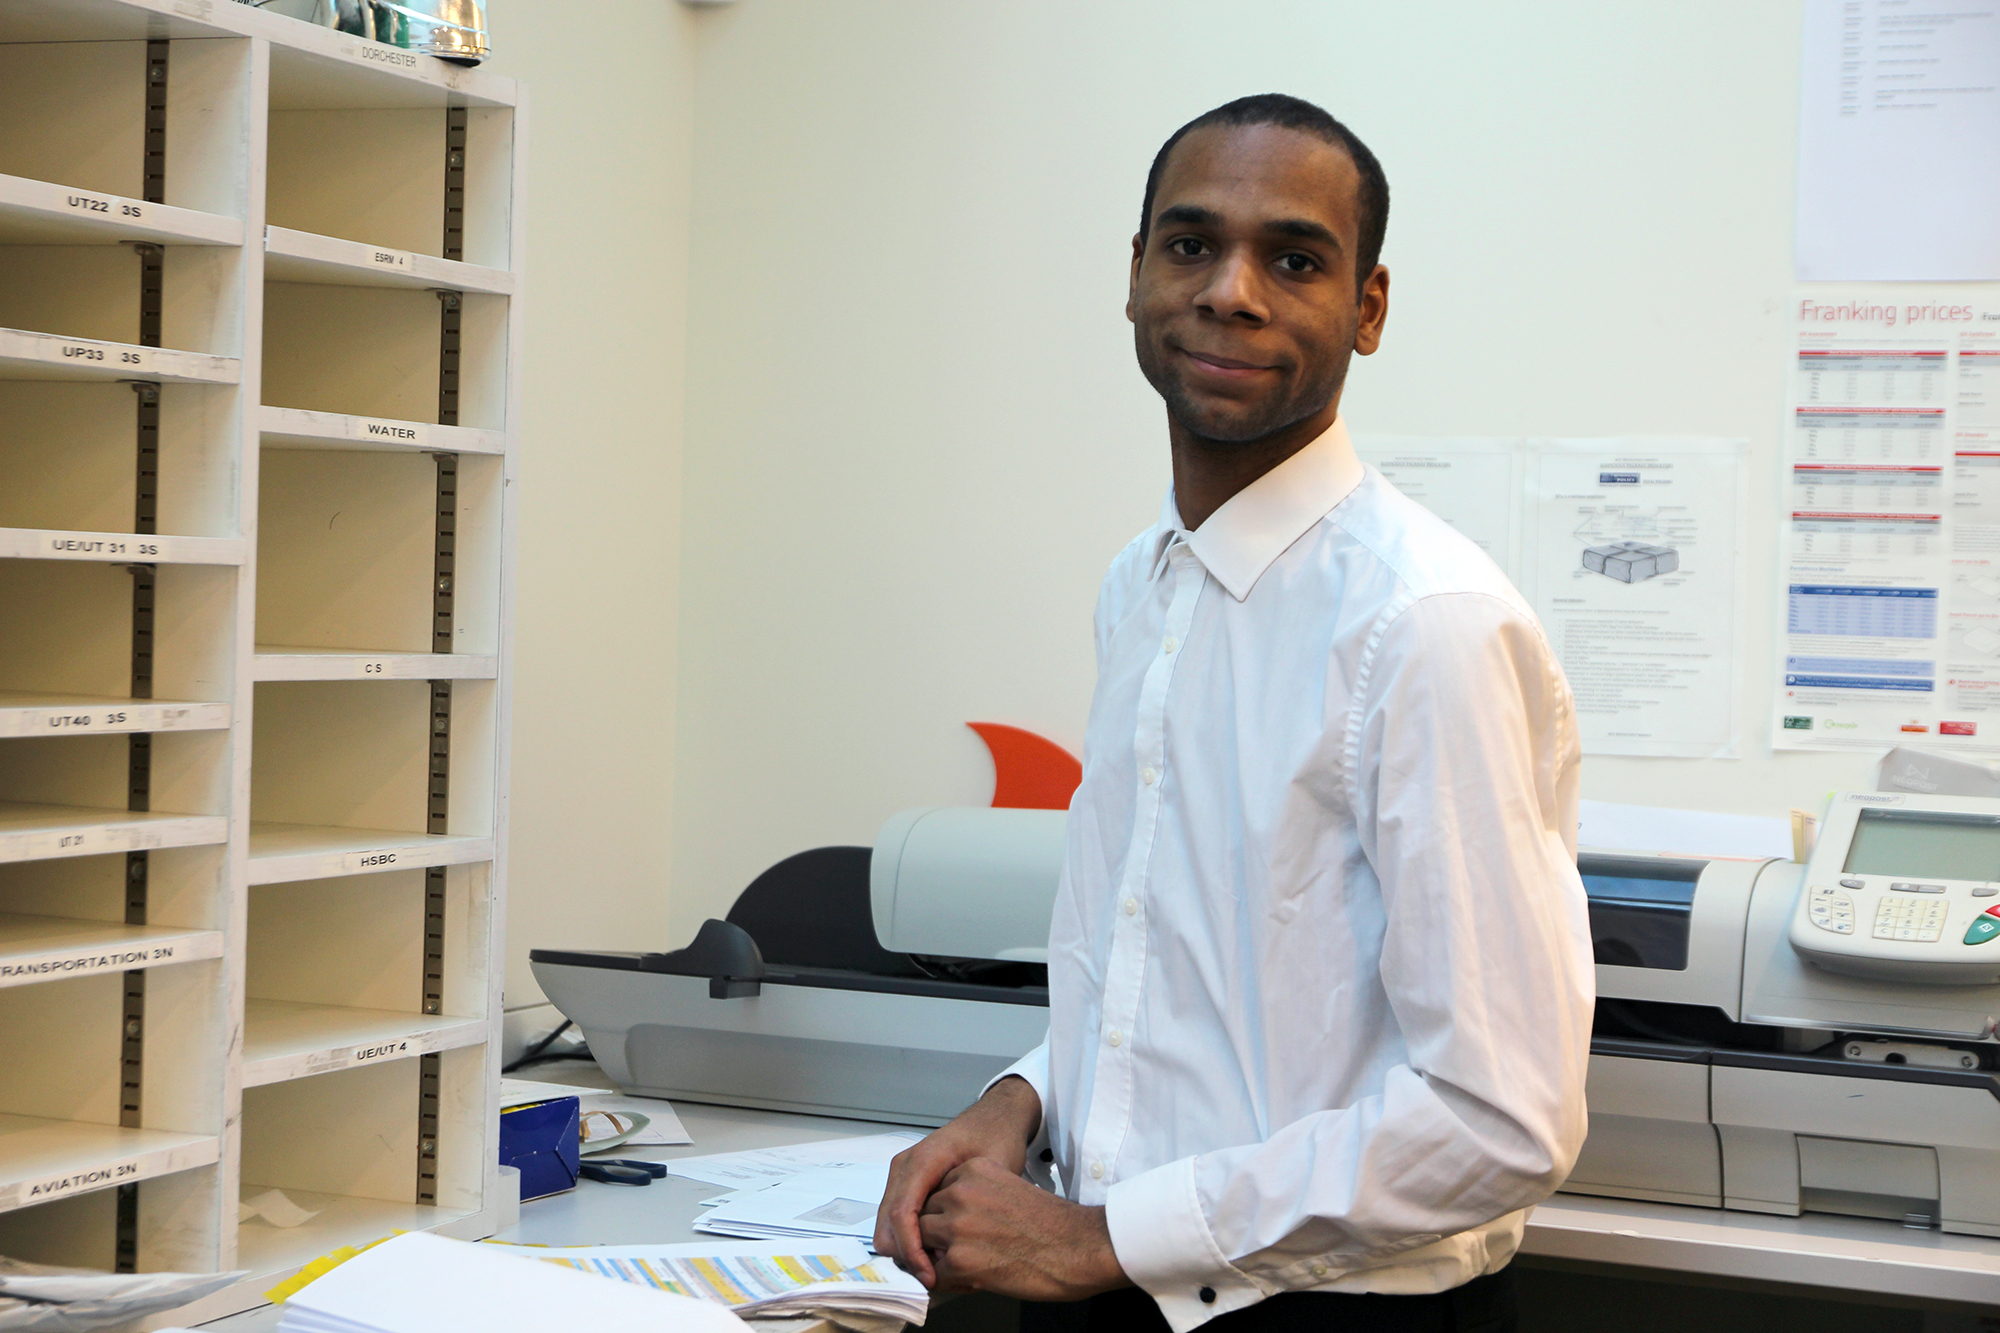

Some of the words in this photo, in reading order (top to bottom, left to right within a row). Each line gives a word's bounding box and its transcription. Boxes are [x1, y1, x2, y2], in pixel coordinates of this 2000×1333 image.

[362, 46, 417, 68] DORCHESTER
[68, 195, 109, 213] UT22
[122, 205, 142, 218] 3S
[375, 252, 395, 264] ESRM
[399, 257, 404, 265] 4
[1800, 299, 1898, 326] Franking
[1906, 300, 1974, 326] prices
[63, 346, 105, 361] UP33
[121, 352, 141, 364] 3S
[367, 423, 416, 440] WATER
[53, 539, 104, 553] UE/UT
[109, 542, 126, 554] 31
[139, 543, 158, 555] 3S
[365, 663, 373, 674] C
[375, 663, 382, 673] S
[50, 715, 91, 728] UT40
[106, 712, 127, 724] 3S
[1893, 774, 1939, 791] NEOPOST
[1851, 794, 1893, 803] neopost
[361, 853, 397, 867] HSBC
[153, 947, 173, 960] 3N
[357, 1043, 396, 1060] UE/UT
[400, 1041, 407, 1051] 4
[30, 1168, 112, 1197] AVIATION
[117, 1162, 137, 1177] 3N
